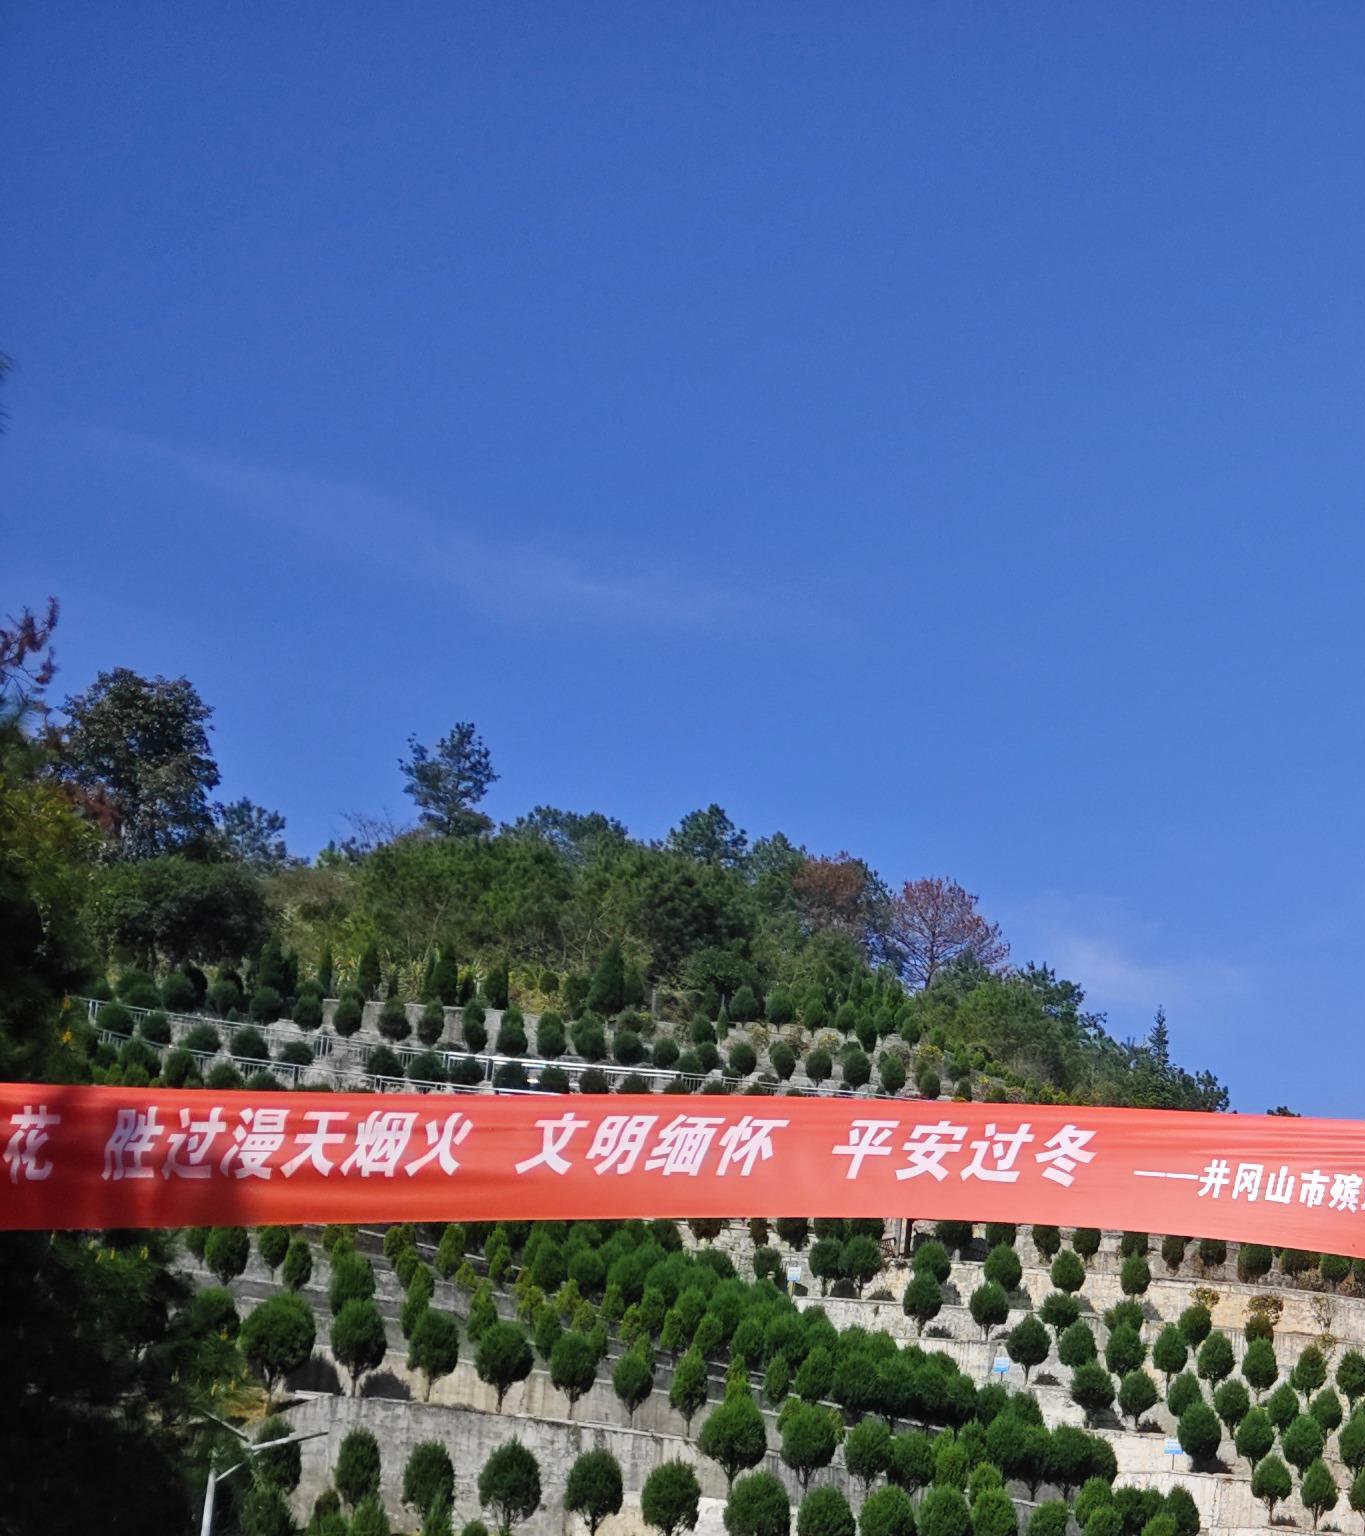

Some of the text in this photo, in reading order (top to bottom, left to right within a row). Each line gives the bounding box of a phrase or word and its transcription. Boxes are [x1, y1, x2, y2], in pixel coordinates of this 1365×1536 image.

[3, 1105, 61, 1184] 花
[101, 1106, 474, 1180] 胜过漫天烟火
[515, 1112, 789, 1176] 文明缅怀
[831, 1119, 1096, 1188] 平安过冬
